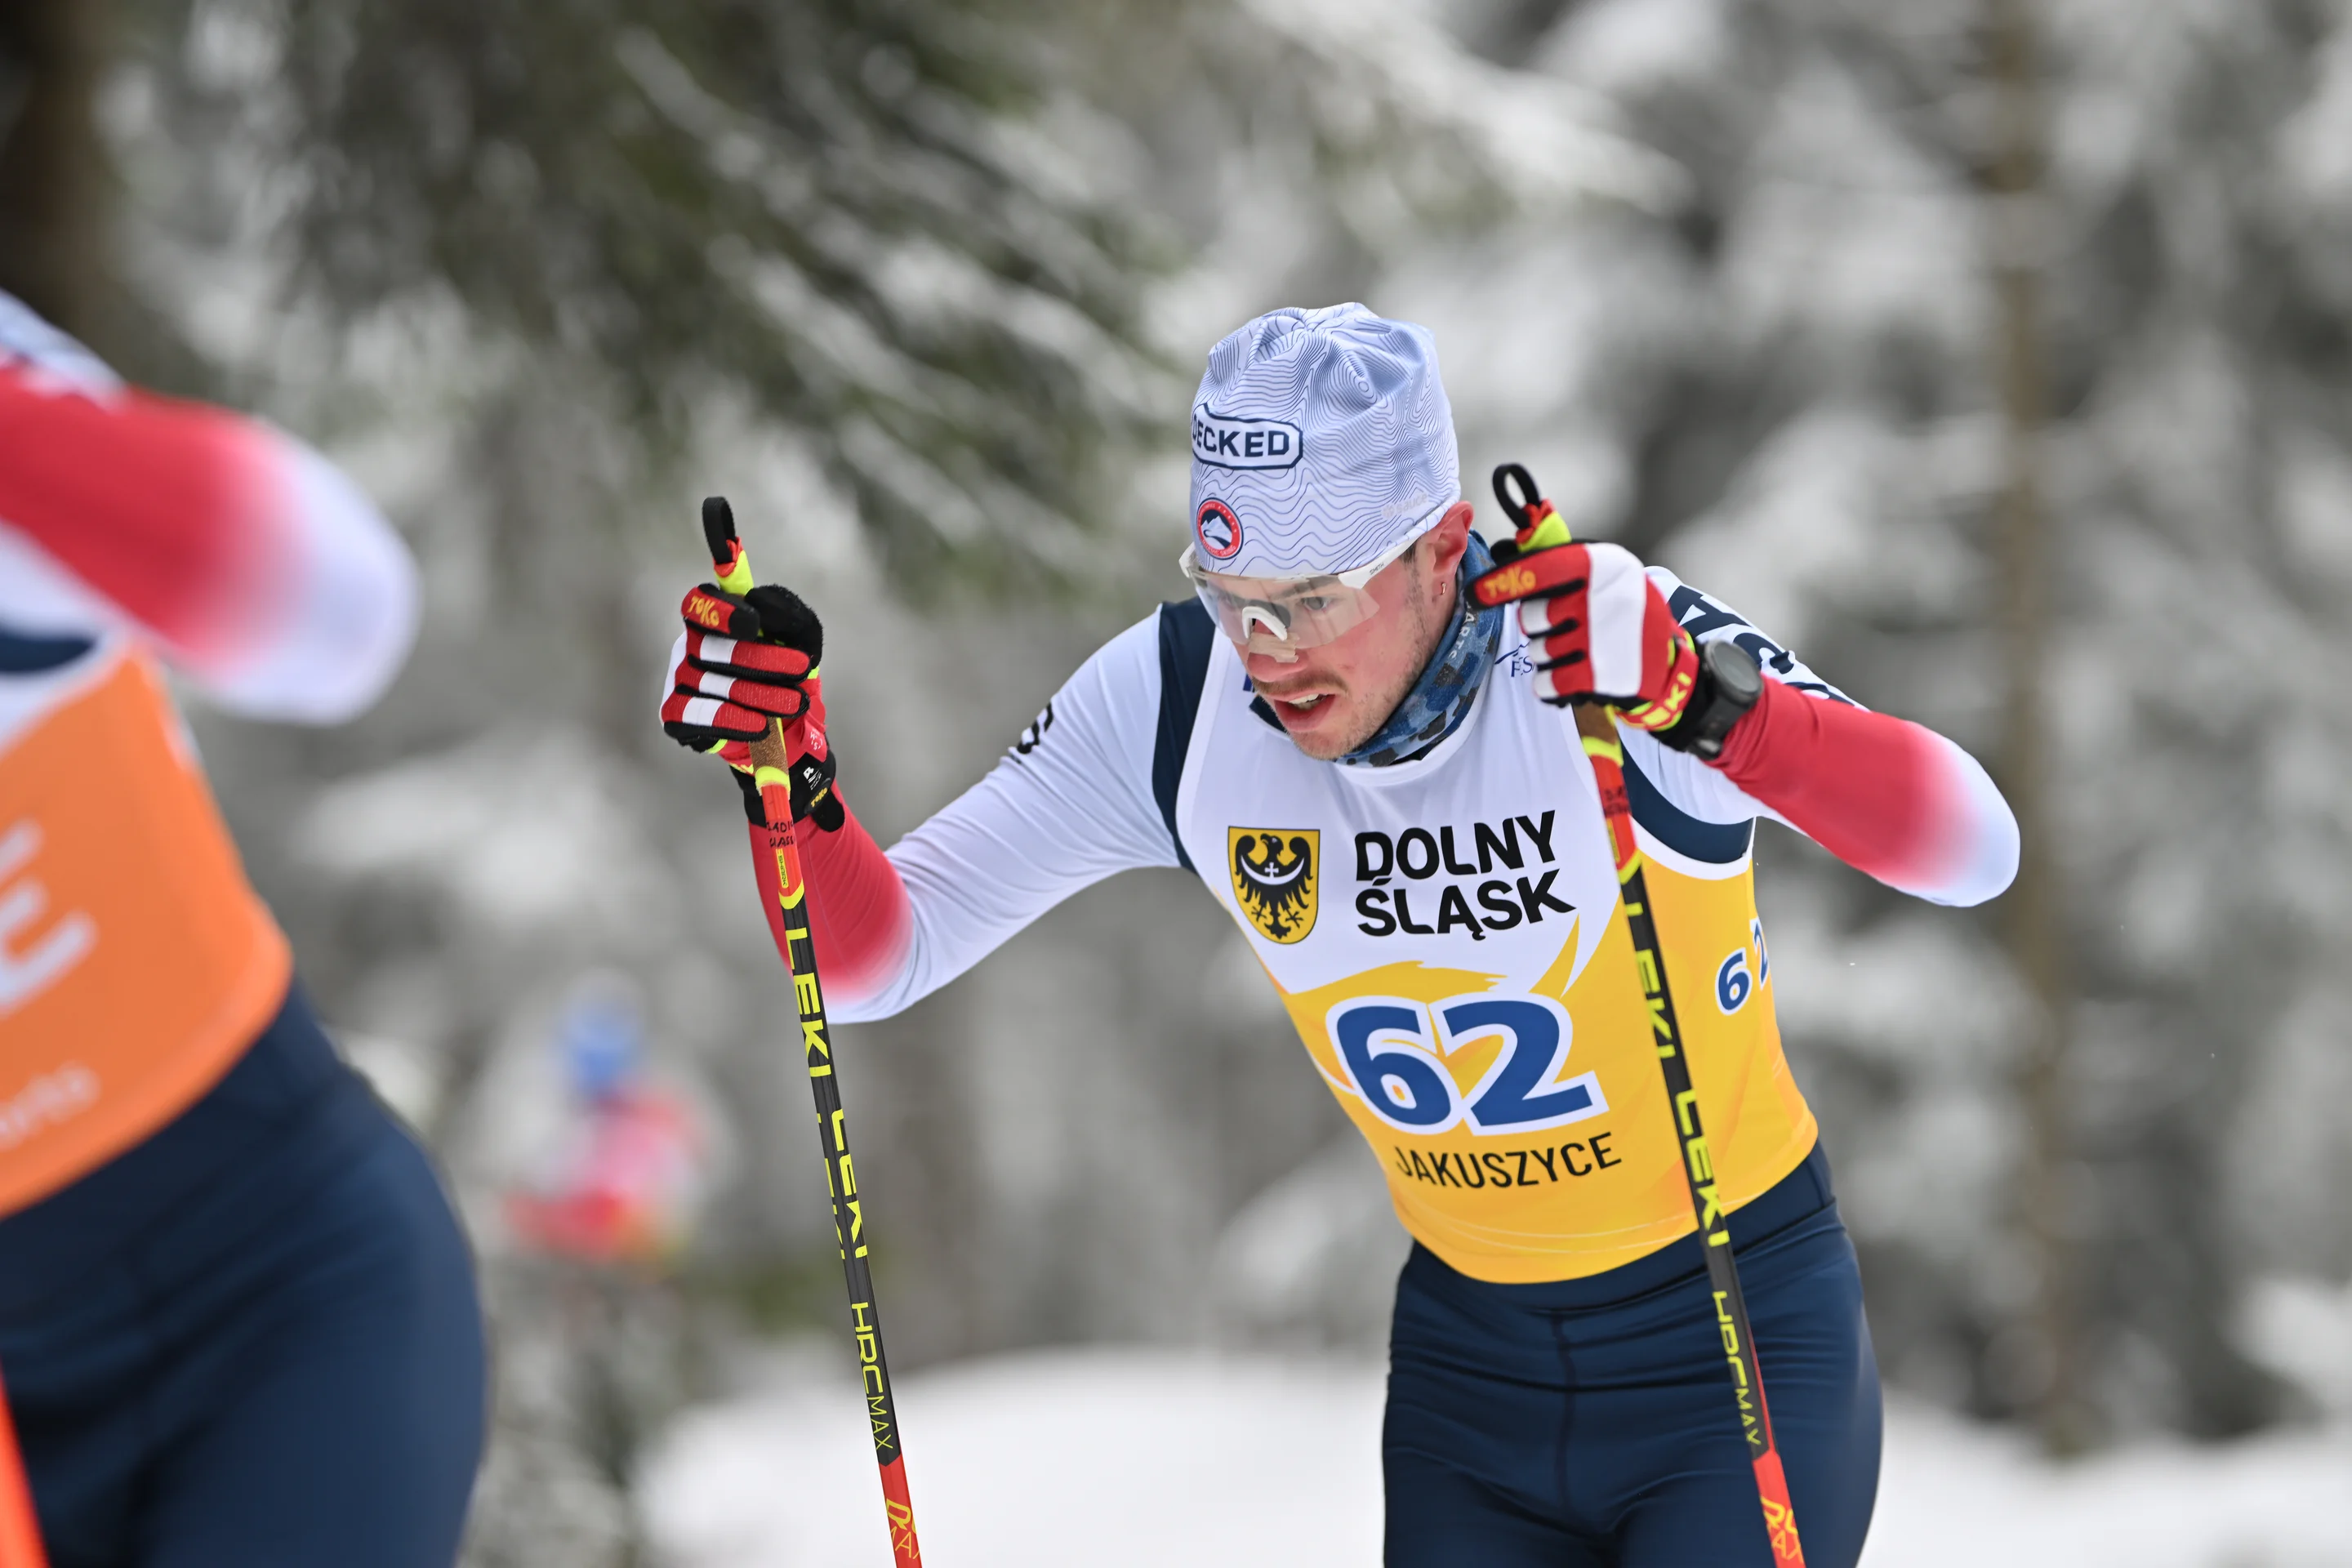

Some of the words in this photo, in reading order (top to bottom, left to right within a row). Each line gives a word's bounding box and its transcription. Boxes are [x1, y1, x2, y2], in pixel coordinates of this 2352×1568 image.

[1192, 414, 1290, 457] DECKED
[1369, 562, 1385, 575] SMITH
[1483, 564, 1536, 599] TOKO
[686, 595, 719, 627] TOKO
[810, 787, 828, 808] TOKO
[1355, 810, 1556, 882] DOLNY
[1354, 868, 1577, 941] ŚLĄSK
[785, 926, 832, 1078] LEKI
[1326, 991, 1610, 1136] 62
[1395, 1131, 1623, 1189] JAKUSZYCE
[1675, 1088, 1731, 1248] LEKI
